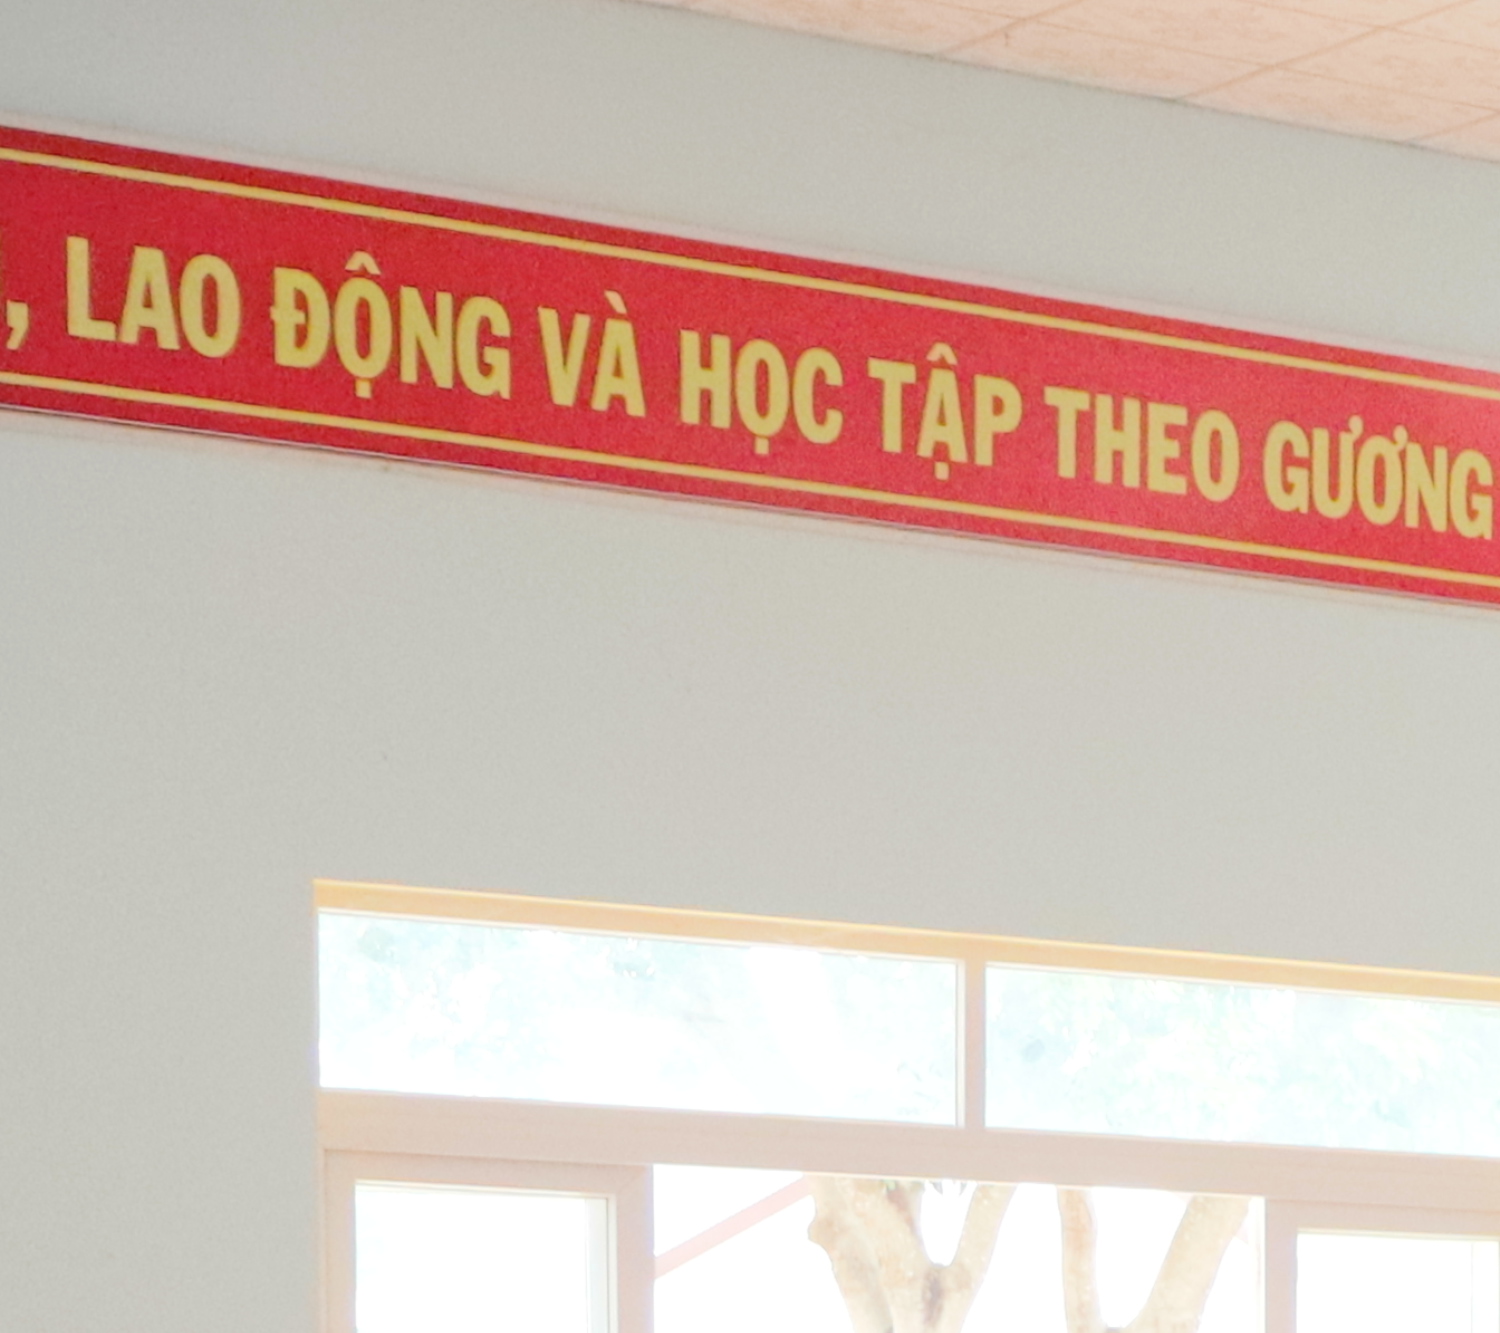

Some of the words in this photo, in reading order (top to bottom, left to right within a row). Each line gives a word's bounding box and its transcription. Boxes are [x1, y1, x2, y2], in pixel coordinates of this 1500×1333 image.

[66, 236, 241, 358] LAO
[270, 251, 511, 399] ĐỘNG
[538, 290, 646, 417] VÀ
[680, 330, 844, 455] HỌC
[867, 342, 1023, 481] TẬP
[1043, 386, 1241, 502] THEO
[1262, 415, 1494, 539] GƯƠNG
